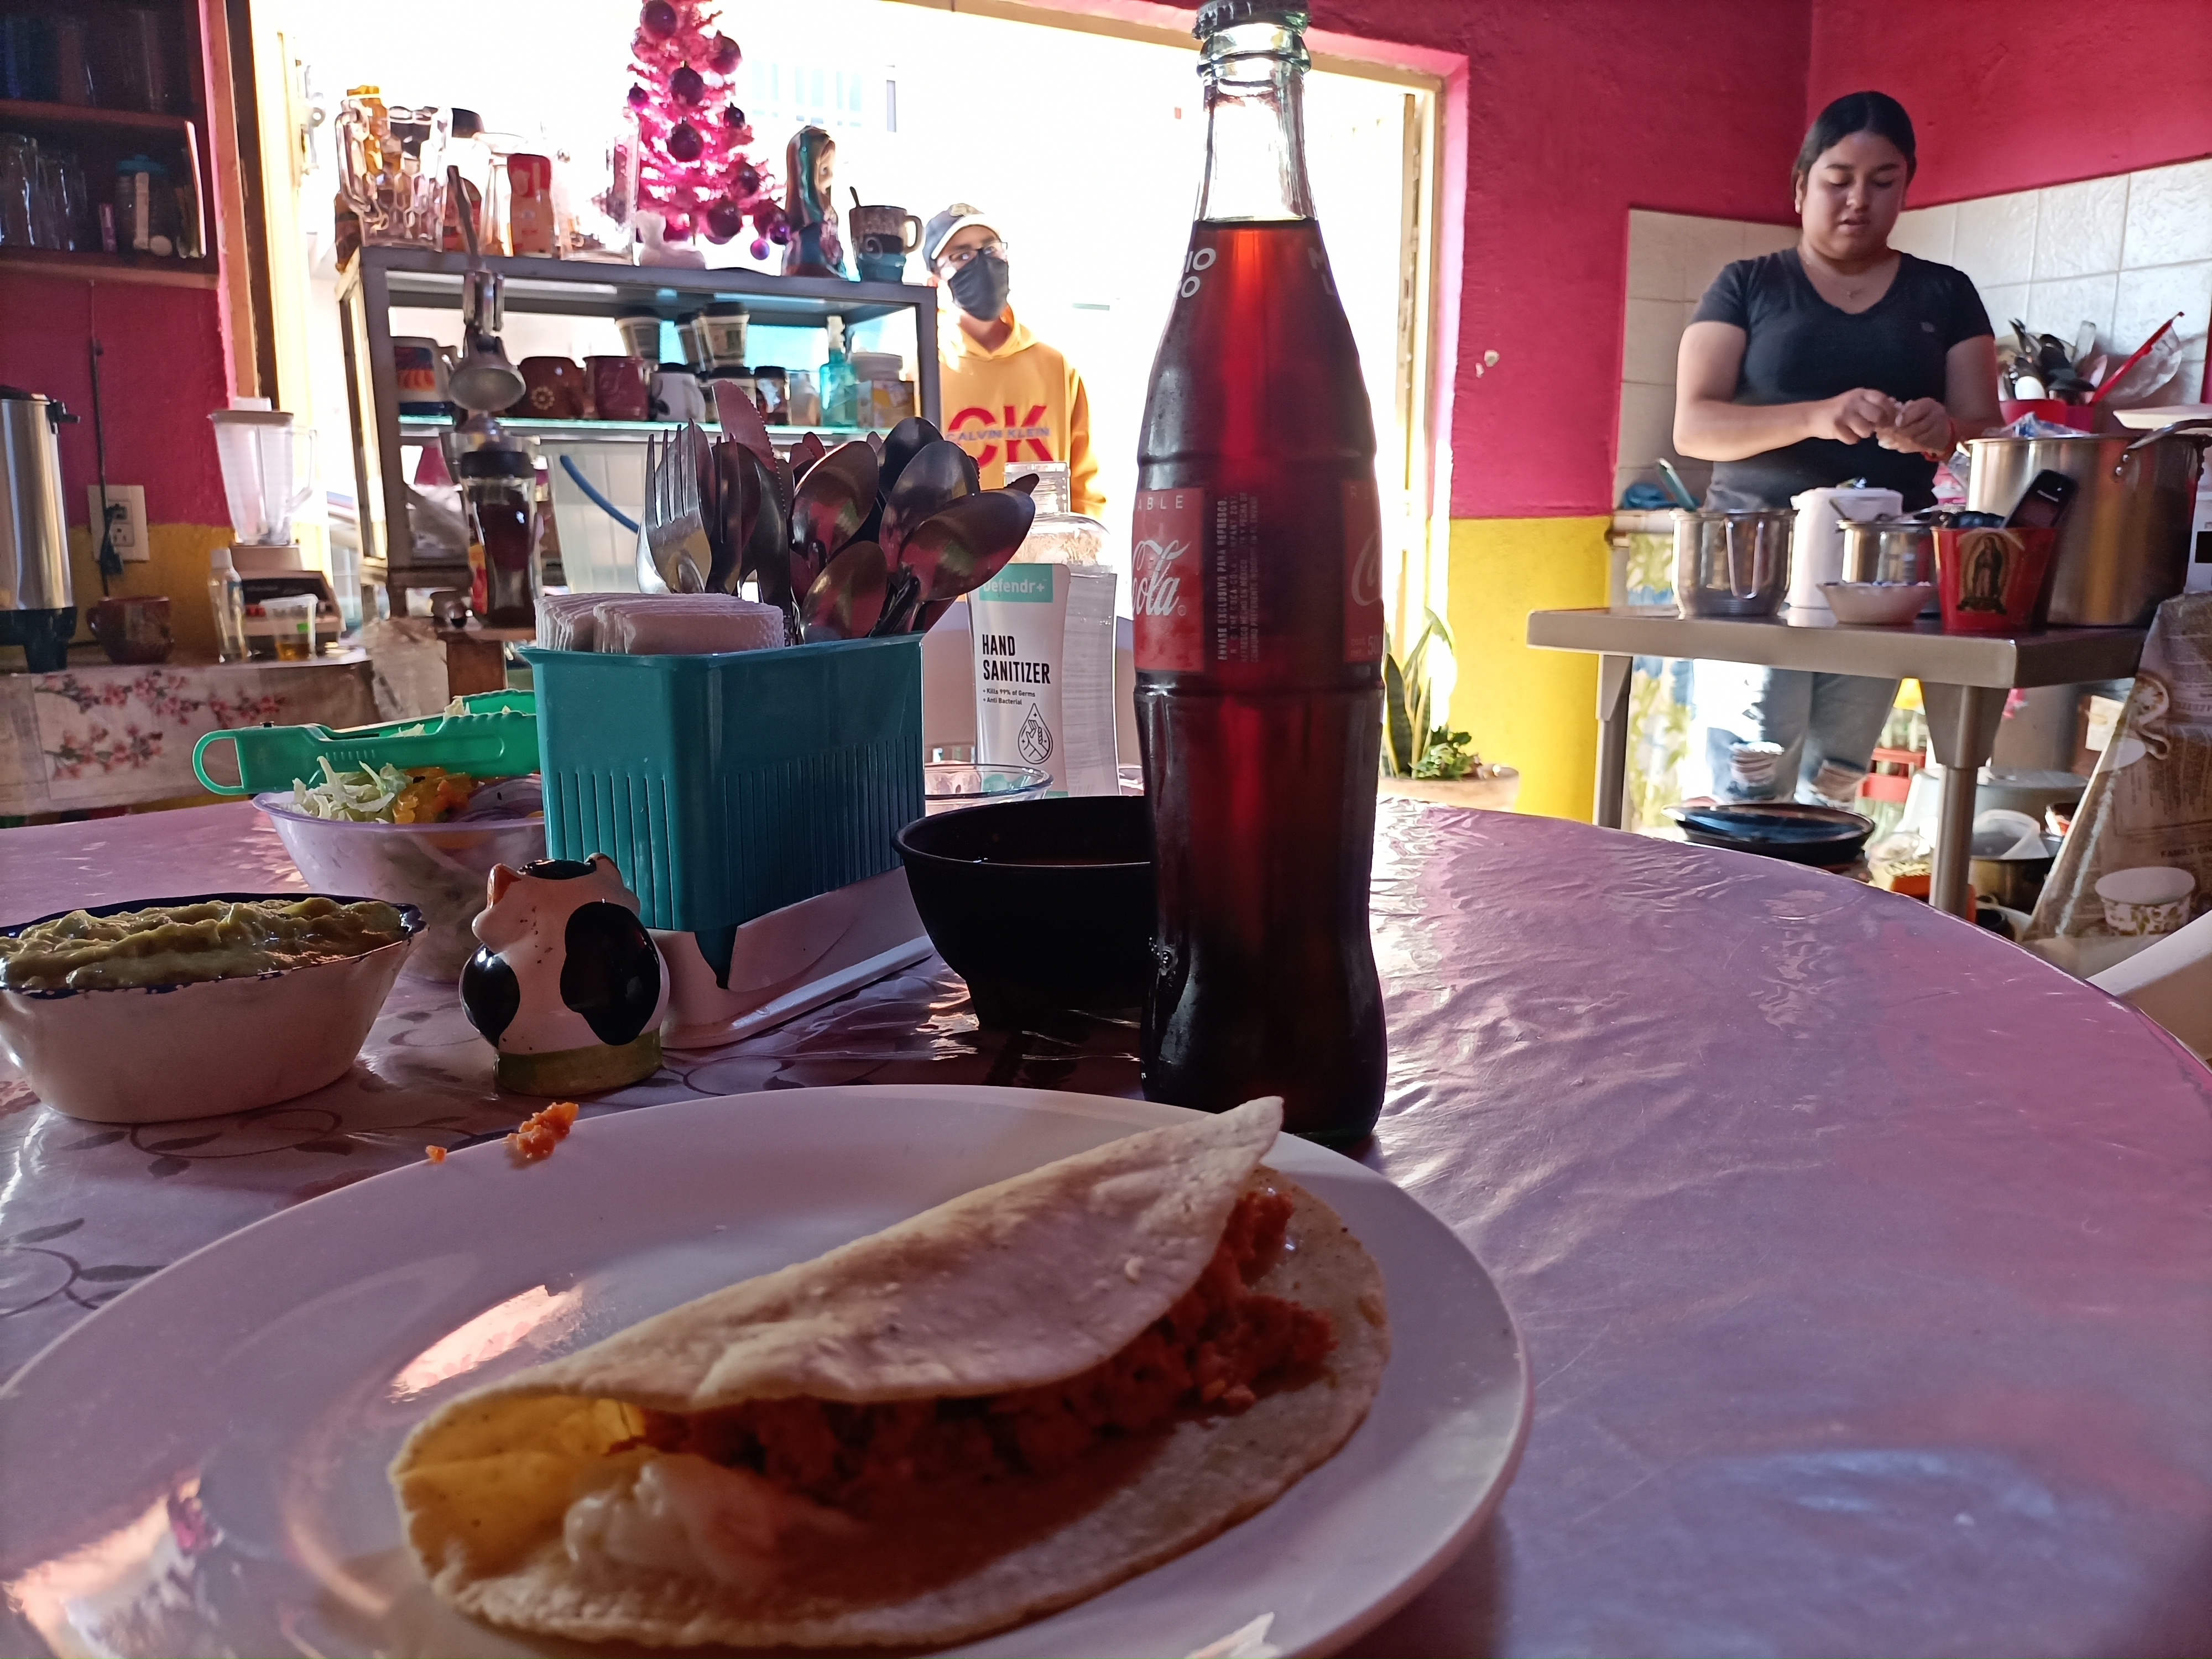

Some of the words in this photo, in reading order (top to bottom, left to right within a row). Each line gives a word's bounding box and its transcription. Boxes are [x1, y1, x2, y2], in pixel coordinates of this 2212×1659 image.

[947, 429, 1003, 441] CALVIN
[1007, 427, 1050, 438] KLEIN
[1137, 495, 1183, 511] ABLE
[982, 634, 1015, 656] HAND
[983, 659, 1051, 684] SANITIZER
